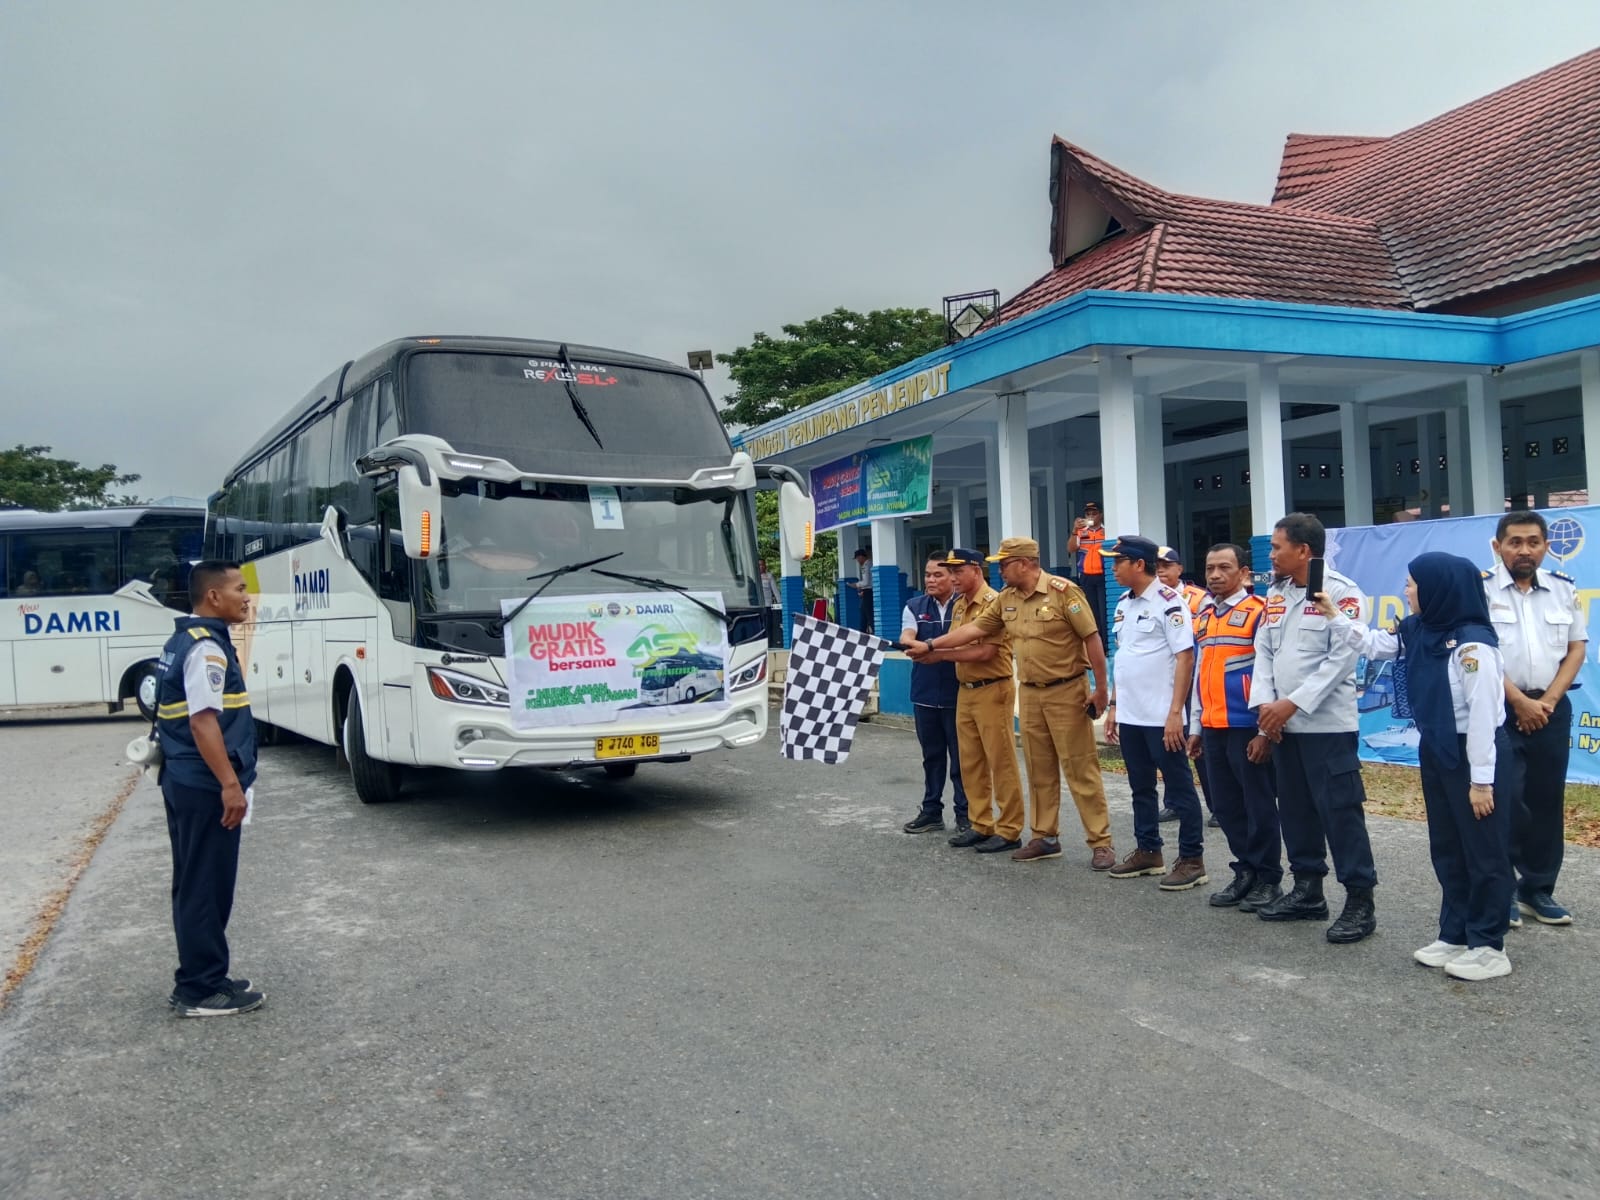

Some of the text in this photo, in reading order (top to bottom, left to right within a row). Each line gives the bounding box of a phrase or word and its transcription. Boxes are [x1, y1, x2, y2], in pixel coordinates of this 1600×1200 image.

[580, 364, 606, 373] MAS
[745, 428, 785, 461] TUNGGU
[600, 500, 615, 520] 1
[294, 568, 330, 611] DAMRI
[636, 604, 674, 615] DAMRI
[24, 610, 121, 634] DAMRI
[528, 621, 599, 643] MUDIK
[530, 638, 606, 660] GRATIS
[549, 658, 616, 672] bersama
[597, 739, 604, 751] B
